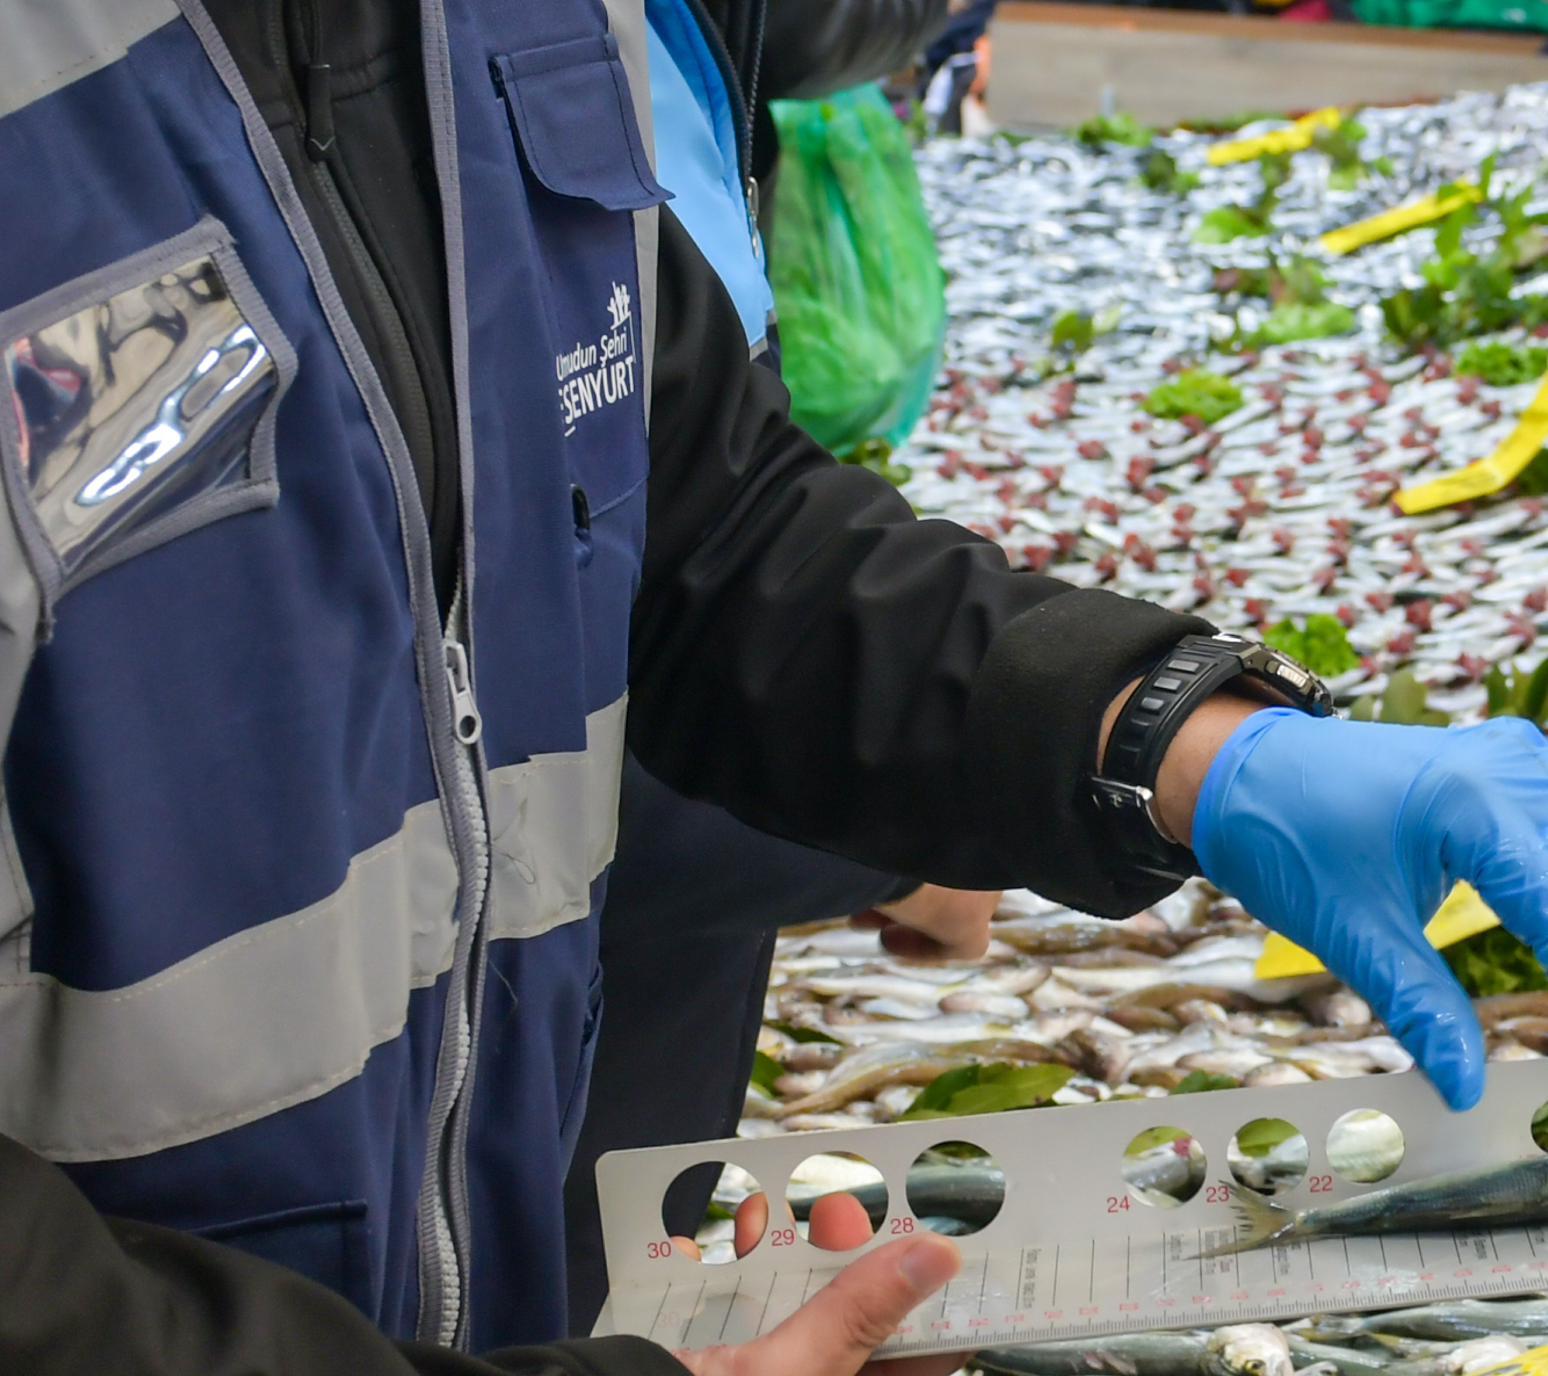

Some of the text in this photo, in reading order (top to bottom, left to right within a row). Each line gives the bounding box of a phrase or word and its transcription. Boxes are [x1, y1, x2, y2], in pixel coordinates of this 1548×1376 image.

[599, 325, 627, 368] Şehri
[1309, 1176, 1333, 1193] 22
[1206, 1186, 1230, 1203] 23
[1107, 1196, 1131, 1213] 24
[890, 1217, 915, 1234] 28
[770, 1229, 795, 1246] 29
[647, 1241, 672, 1259] 30
